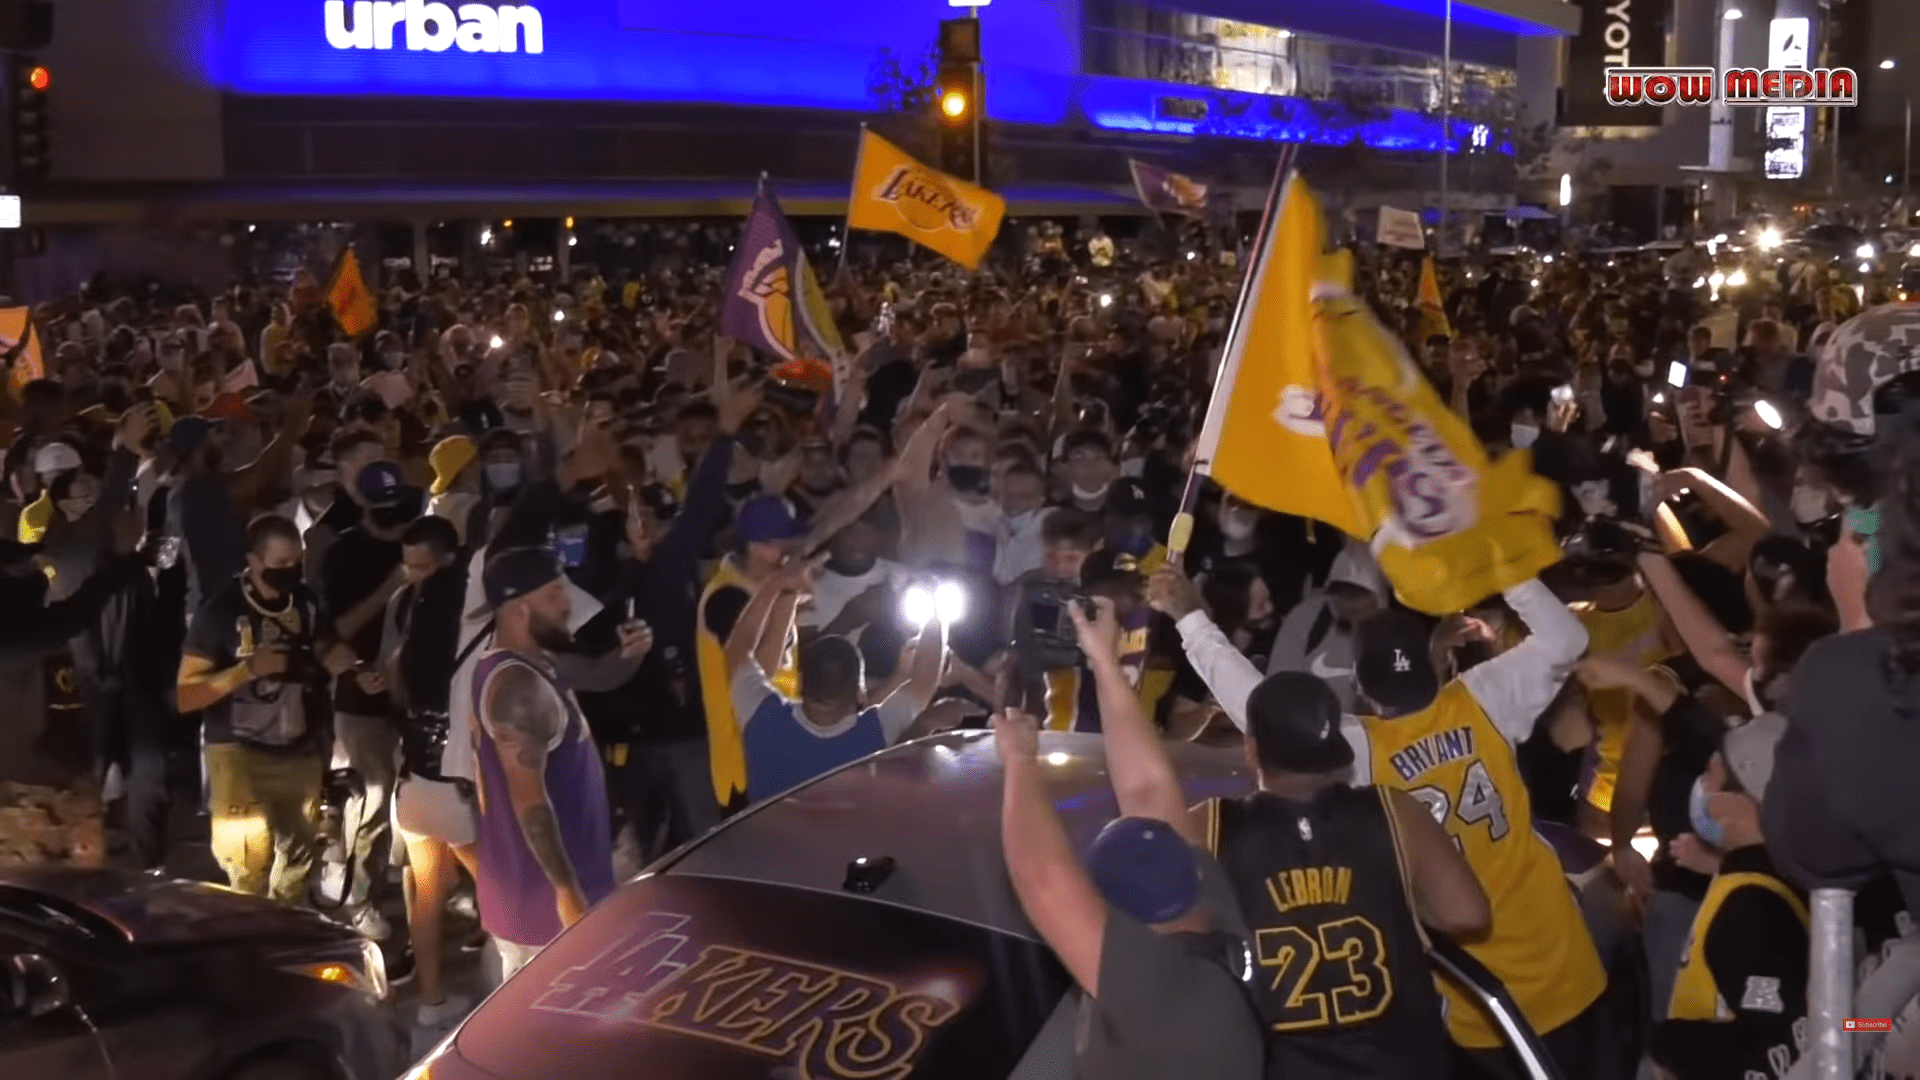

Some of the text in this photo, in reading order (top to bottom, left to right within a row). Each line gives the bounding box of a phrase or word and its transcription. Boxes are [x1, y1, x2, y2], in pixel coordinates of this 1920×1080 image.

[323, 0, 544, 54] urban
[1389, 726, 1475, 781] BRYANT
[1265, 865, 1353, 913] LEBRON
[529, 911, 961, 1080] LAKERS
[1255, 915, 1394, 1032] 23
